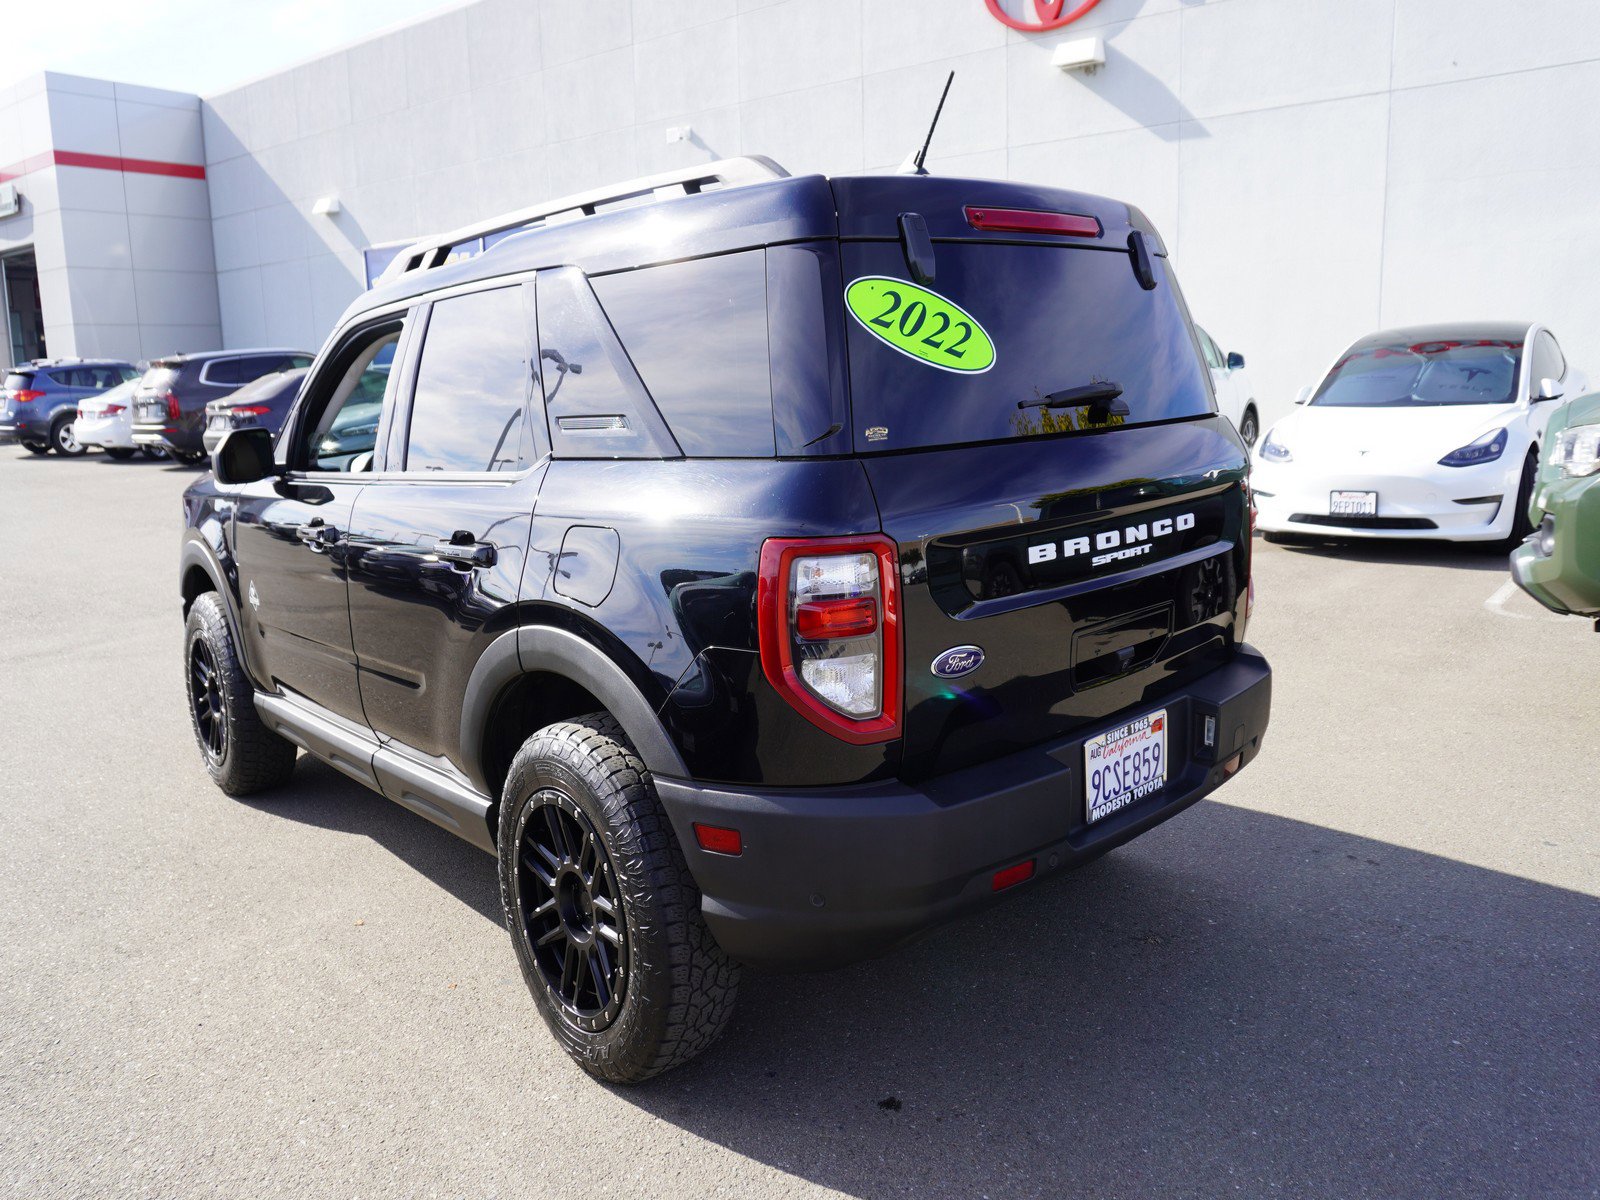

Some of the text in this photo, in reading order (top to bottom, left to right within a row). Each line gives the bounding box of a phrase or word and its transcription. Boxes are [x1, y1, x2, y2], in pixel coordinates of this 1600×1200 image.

[869, 290, 973, 359] 2022
[1028, 512, 1195, 565] BRONCO
[1092, 543, 1153, 567] SPORT
[945, 652, 975, 673] Ford
[1105, 718, 1149, 744] SINCE 1965
[1090, 746, 1102, 760] AUG
[1091, 742, 1161, 808] 9CSE859
[1092, 775, 1164, 821] MODESTO TOYOTA
